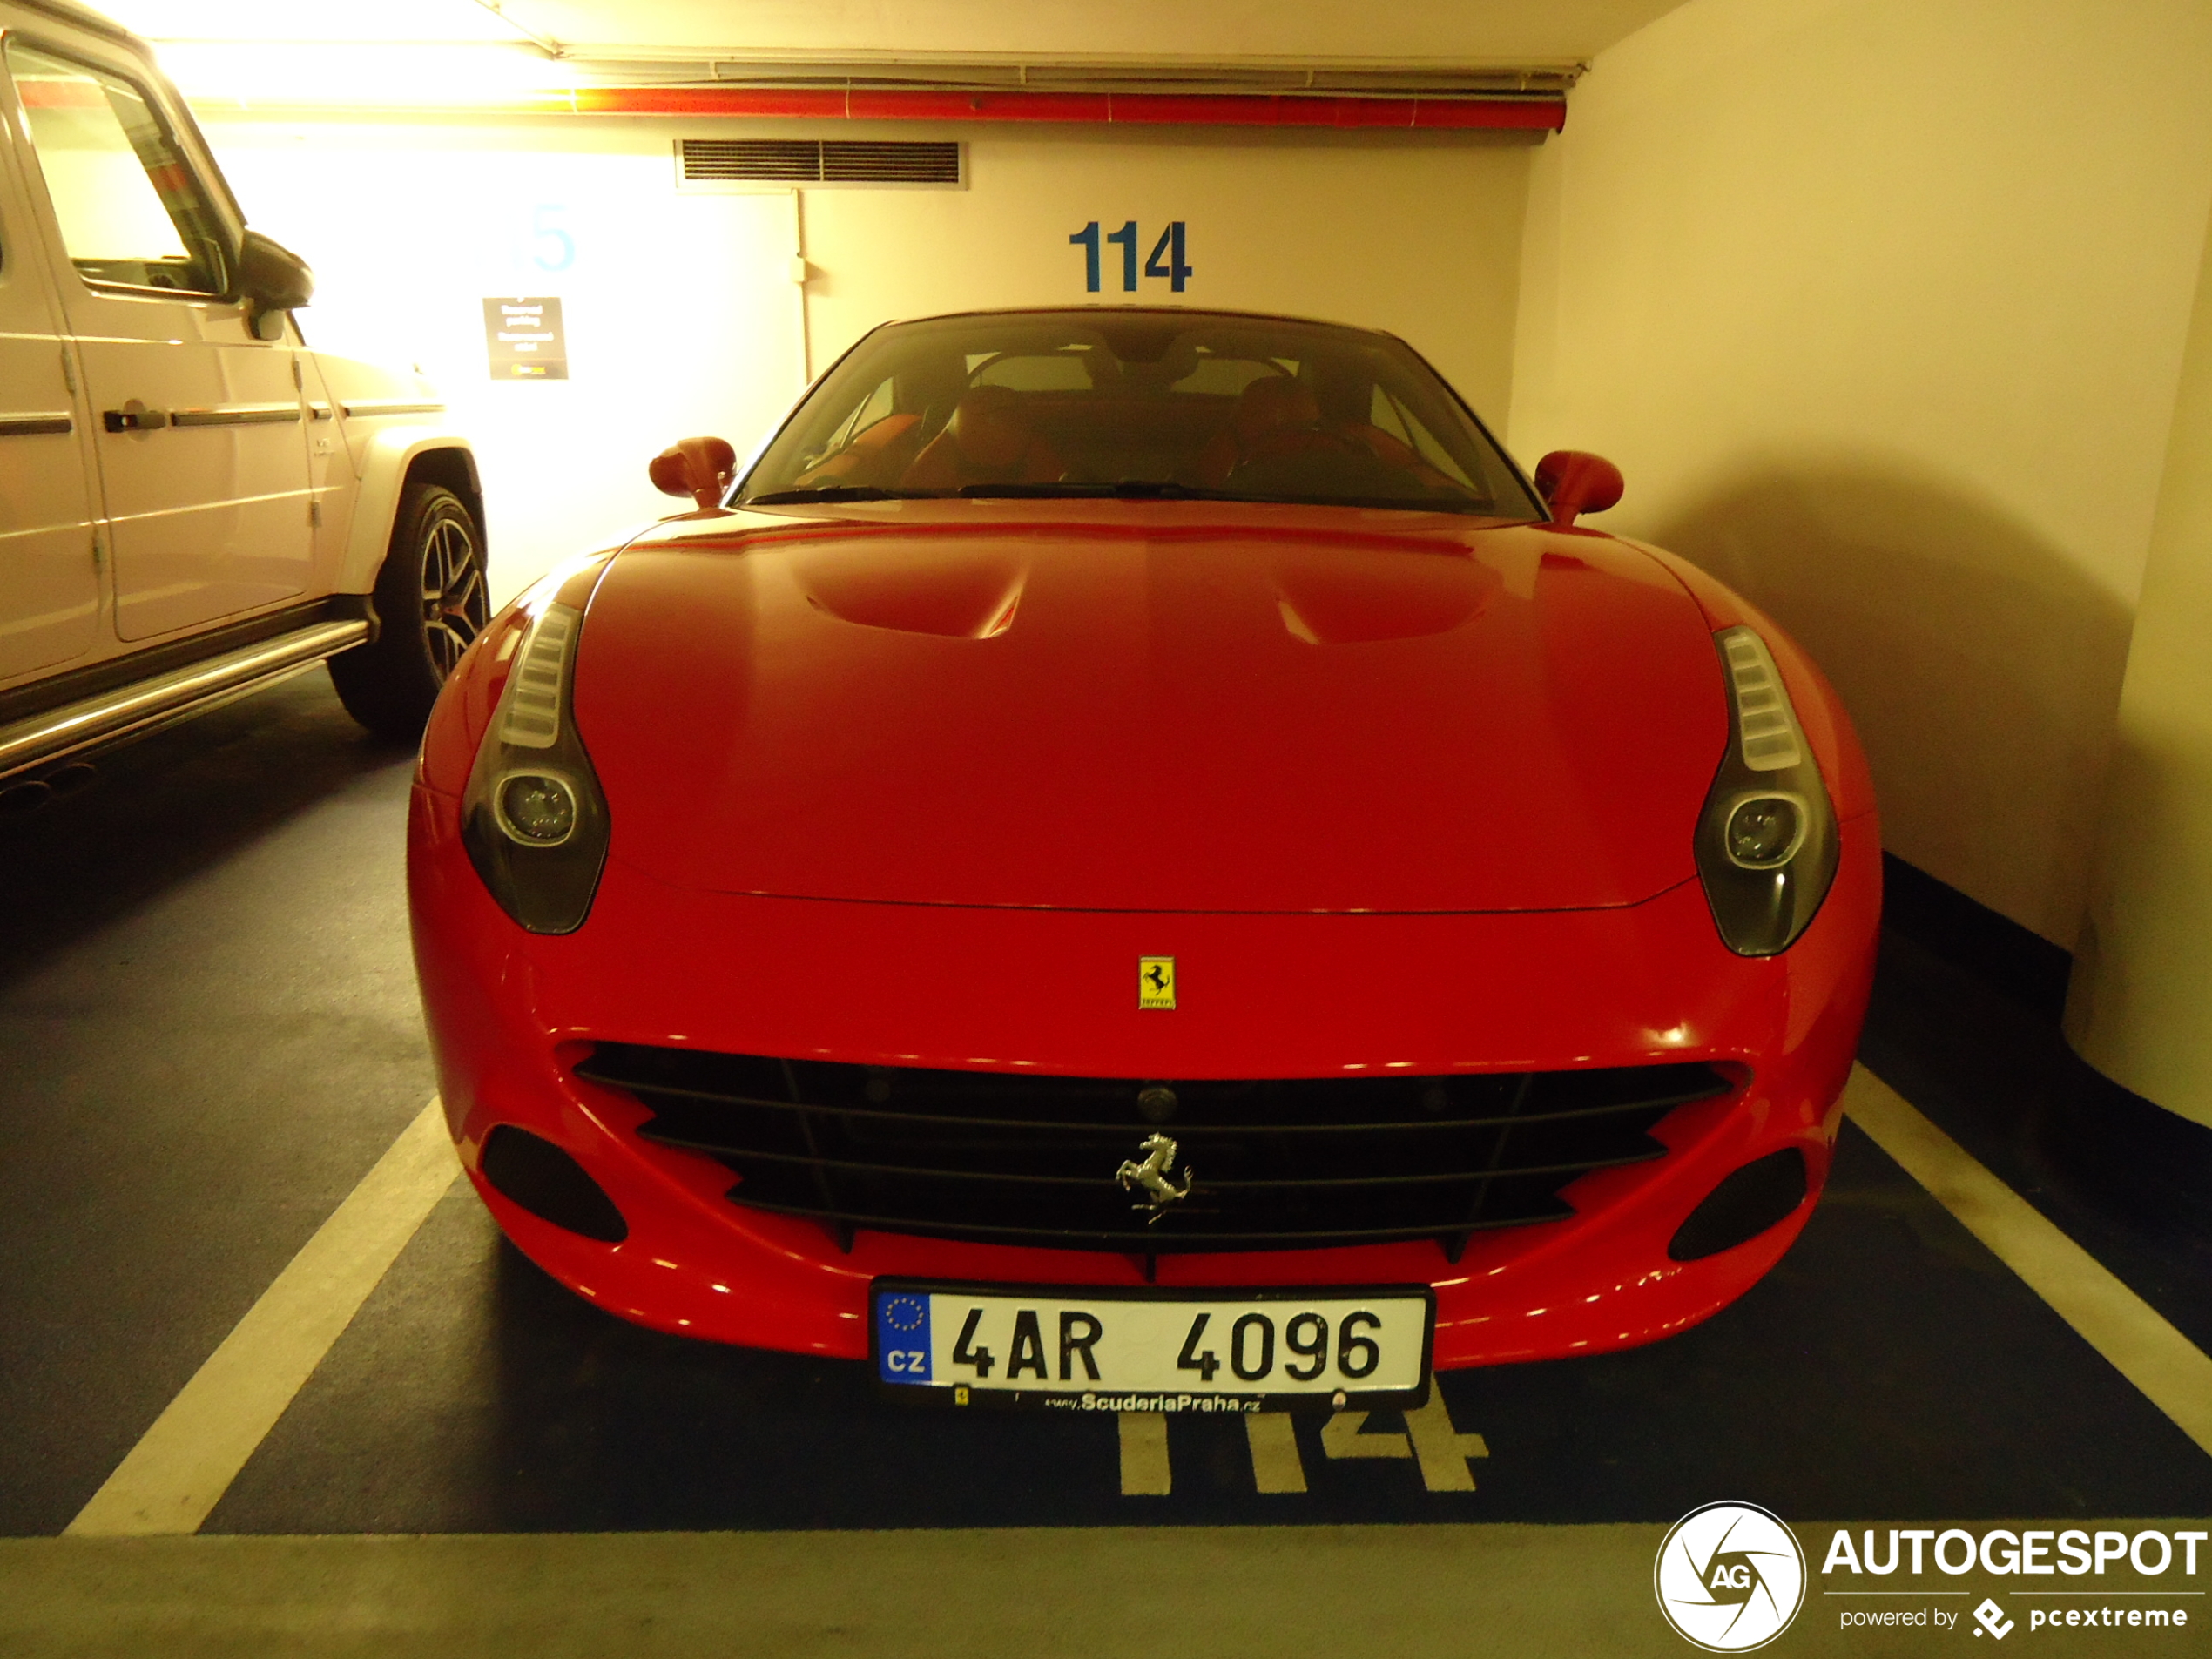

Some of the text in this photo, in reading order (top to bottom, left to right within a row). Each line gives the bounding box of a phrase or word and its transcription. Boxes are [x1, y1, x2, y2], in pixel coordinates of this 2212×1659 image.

[1069, 221, 1192, 292] 114
[887, 1350, 926, 1373] CZ
[953, 1308, 1382, 1381] 4AR 4096
